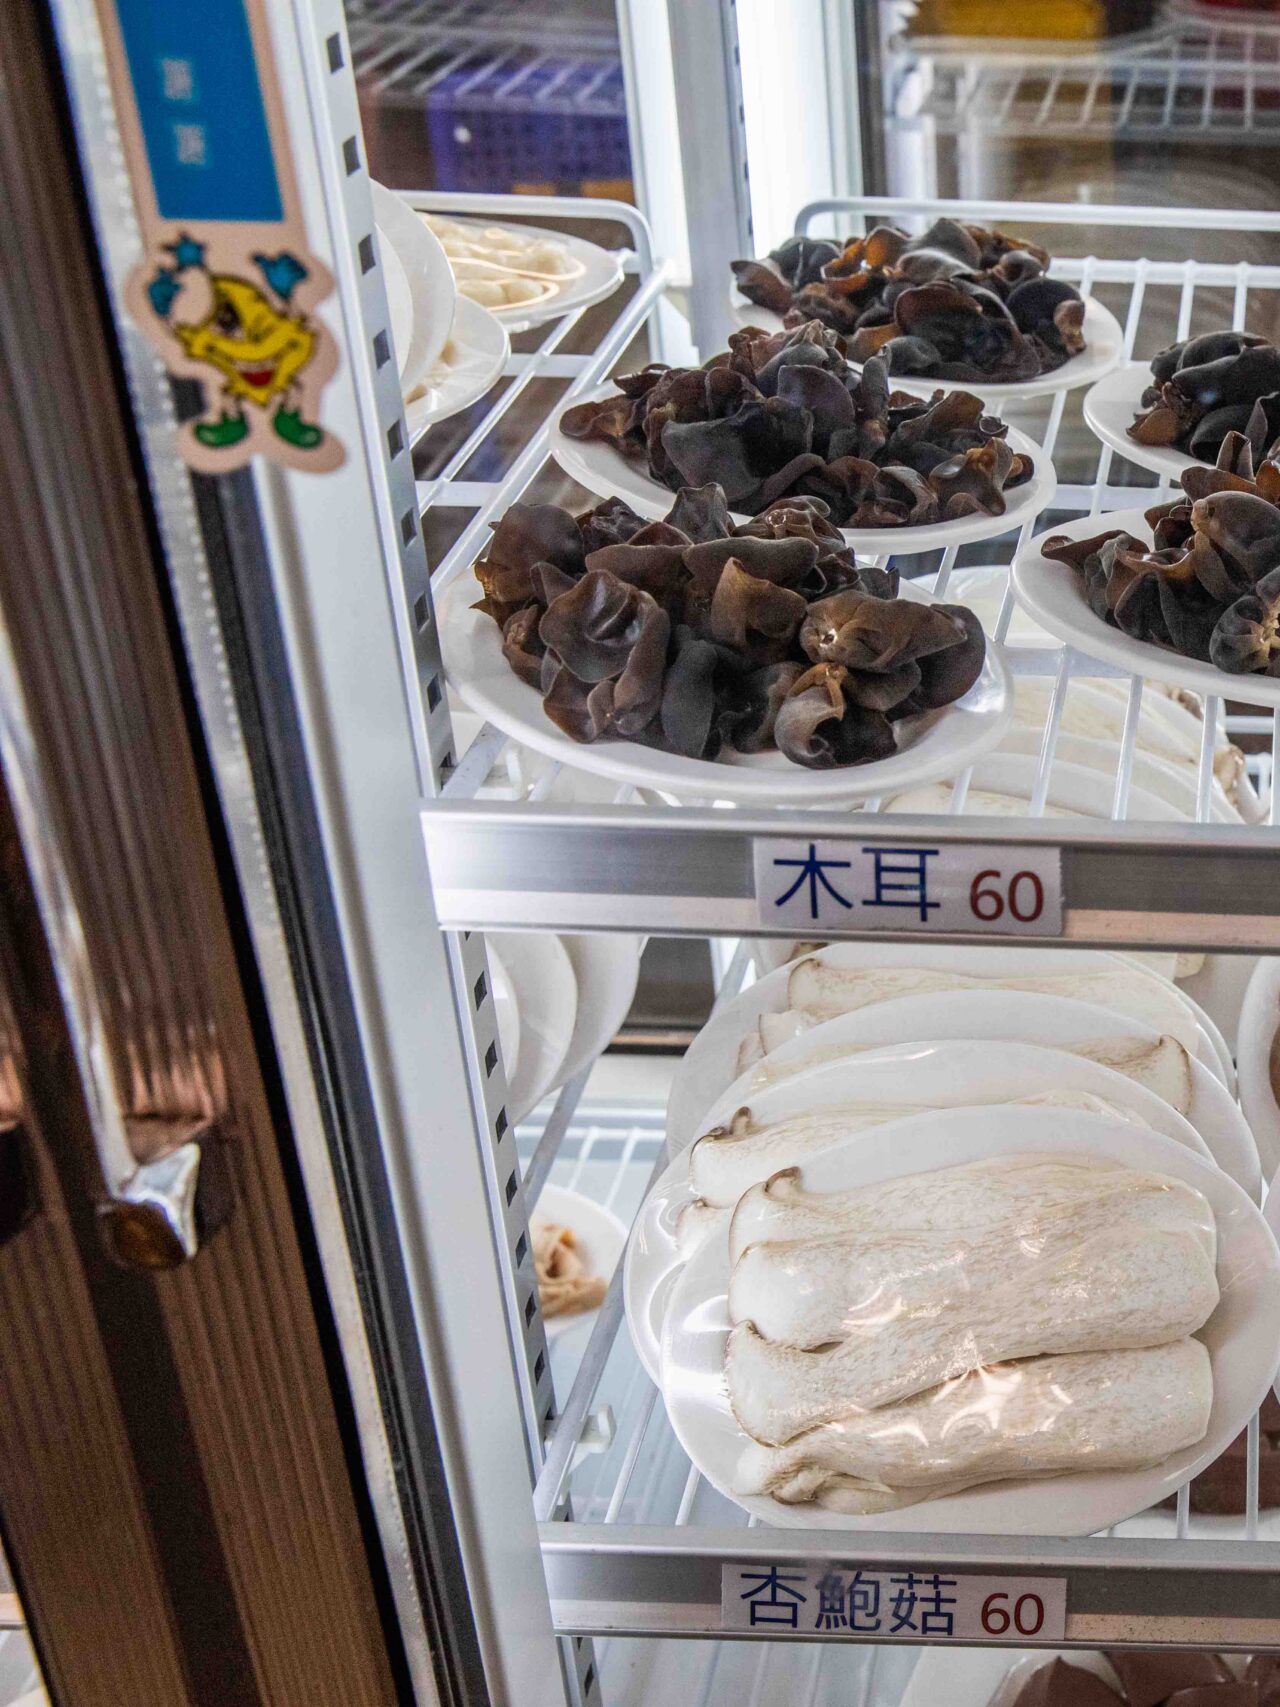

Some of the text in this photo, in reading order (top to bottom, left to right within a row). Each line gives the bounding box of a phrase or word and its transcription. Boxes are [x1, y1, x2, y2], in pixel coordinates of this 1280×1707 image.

[773, 843, 1044, 922] 木耳 60
[740, 1566, 1045, 1636] 杏鮑菇 60
